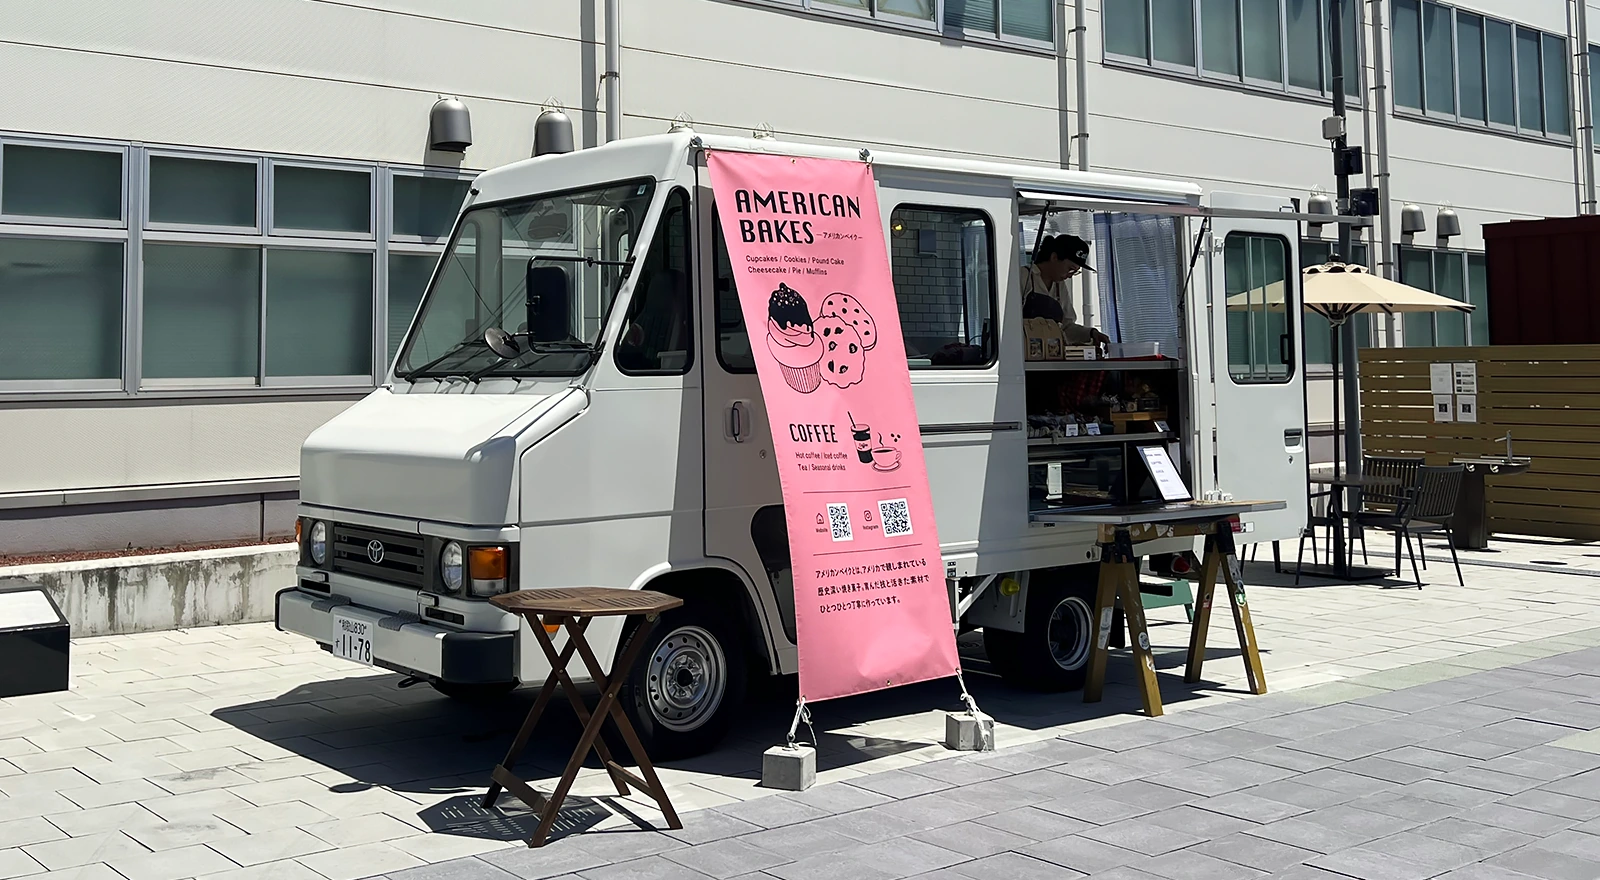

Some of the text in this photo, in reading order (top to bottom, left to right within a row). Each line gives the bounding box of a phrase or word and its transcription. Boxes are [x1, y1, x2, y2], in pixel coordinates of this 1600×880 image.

[735, 189, 861, 219] AMERICAN
[739, 219, 814, 244] BAKES
[745, 255, 778, 263] Cupcakes
[783, 255, 807, 263] Cookies
[747, 266, 787, 274] Cheesecake
[791, 266, 801, 274] Pie
[806, 267, 827, 275] Muffins
[789, 423, 838, 443] COFFEE
[797, 463, 808, 471] Tea
[811, 463, 831, 471] Seasonal
[832, 463, 846, 471] drinks
